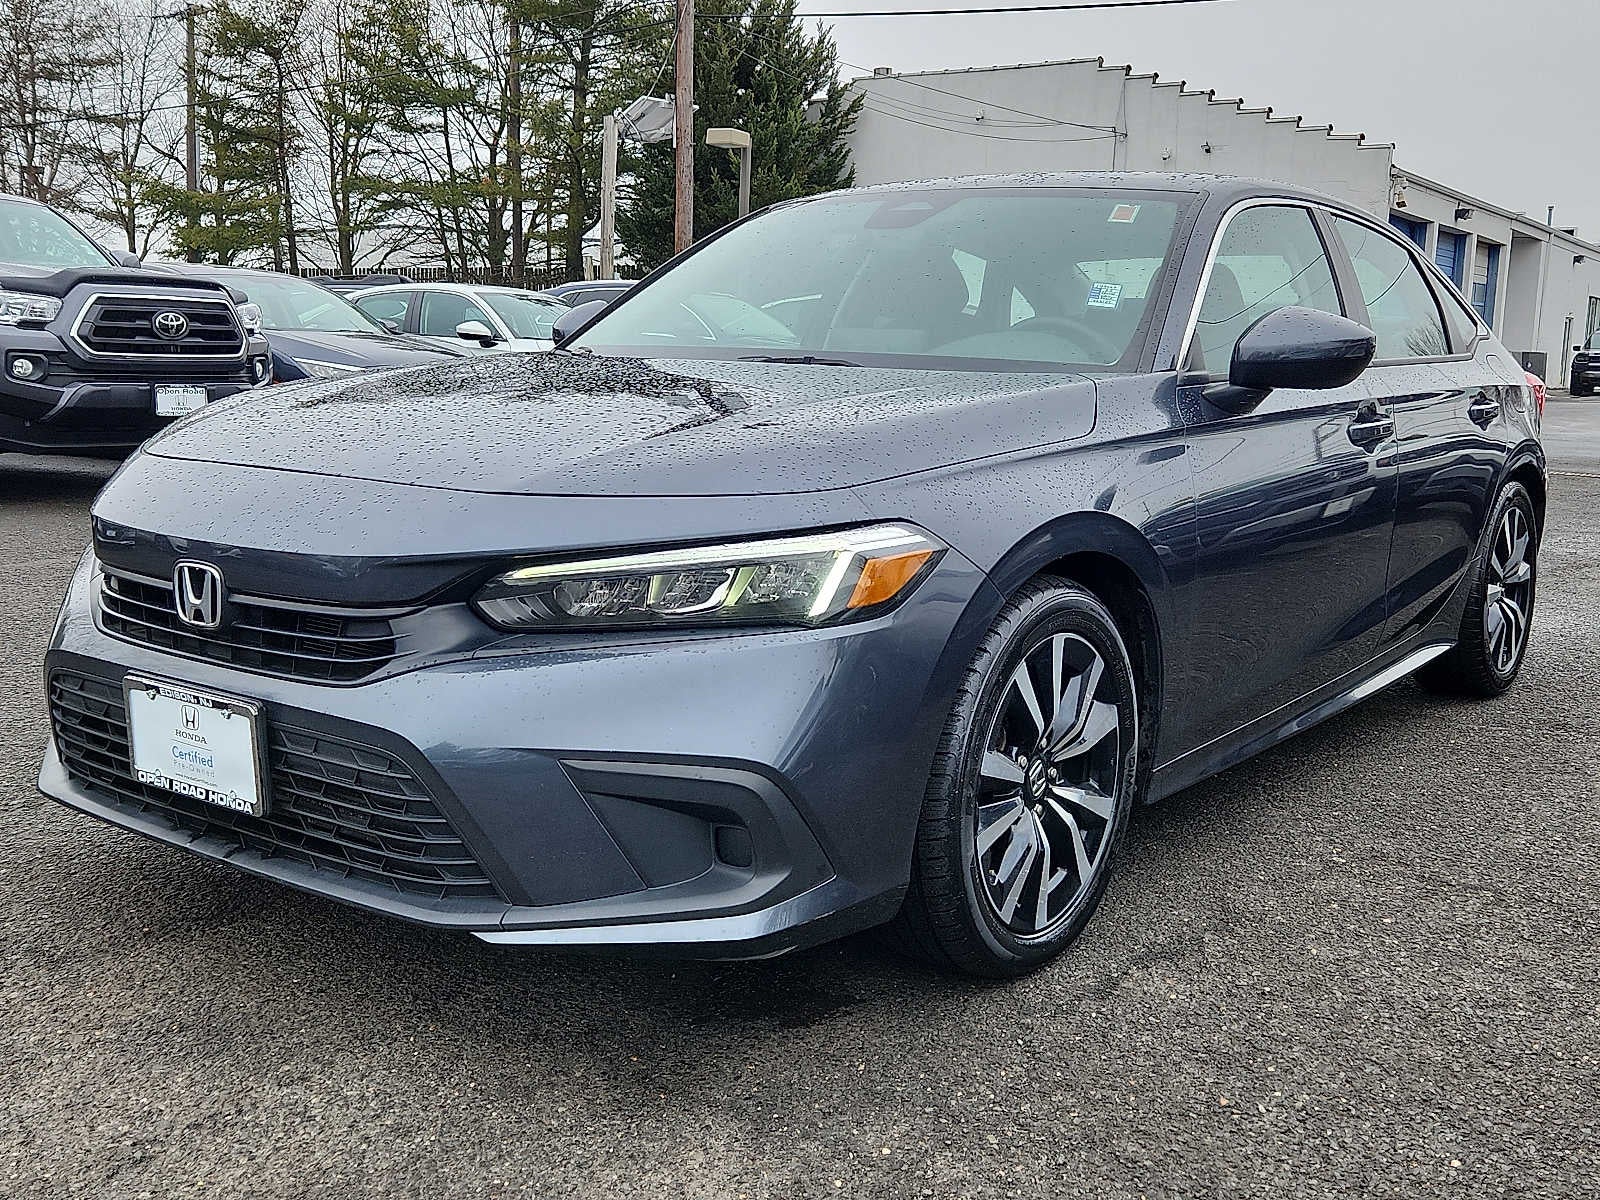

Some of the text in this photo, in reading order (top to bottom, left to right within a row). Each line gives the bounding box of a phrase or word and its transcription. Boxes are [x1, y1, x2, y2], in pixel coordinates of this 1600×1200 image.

[199, 698, 212, 707] NJ
[175, 729, 208, 744] HONDA
[171, 745, 214, 768] Certified
[138, 771, 170, 789] OPEN
[172, 781, 206, 799] ROAD
[208, 790, 254, 815] HONDA
